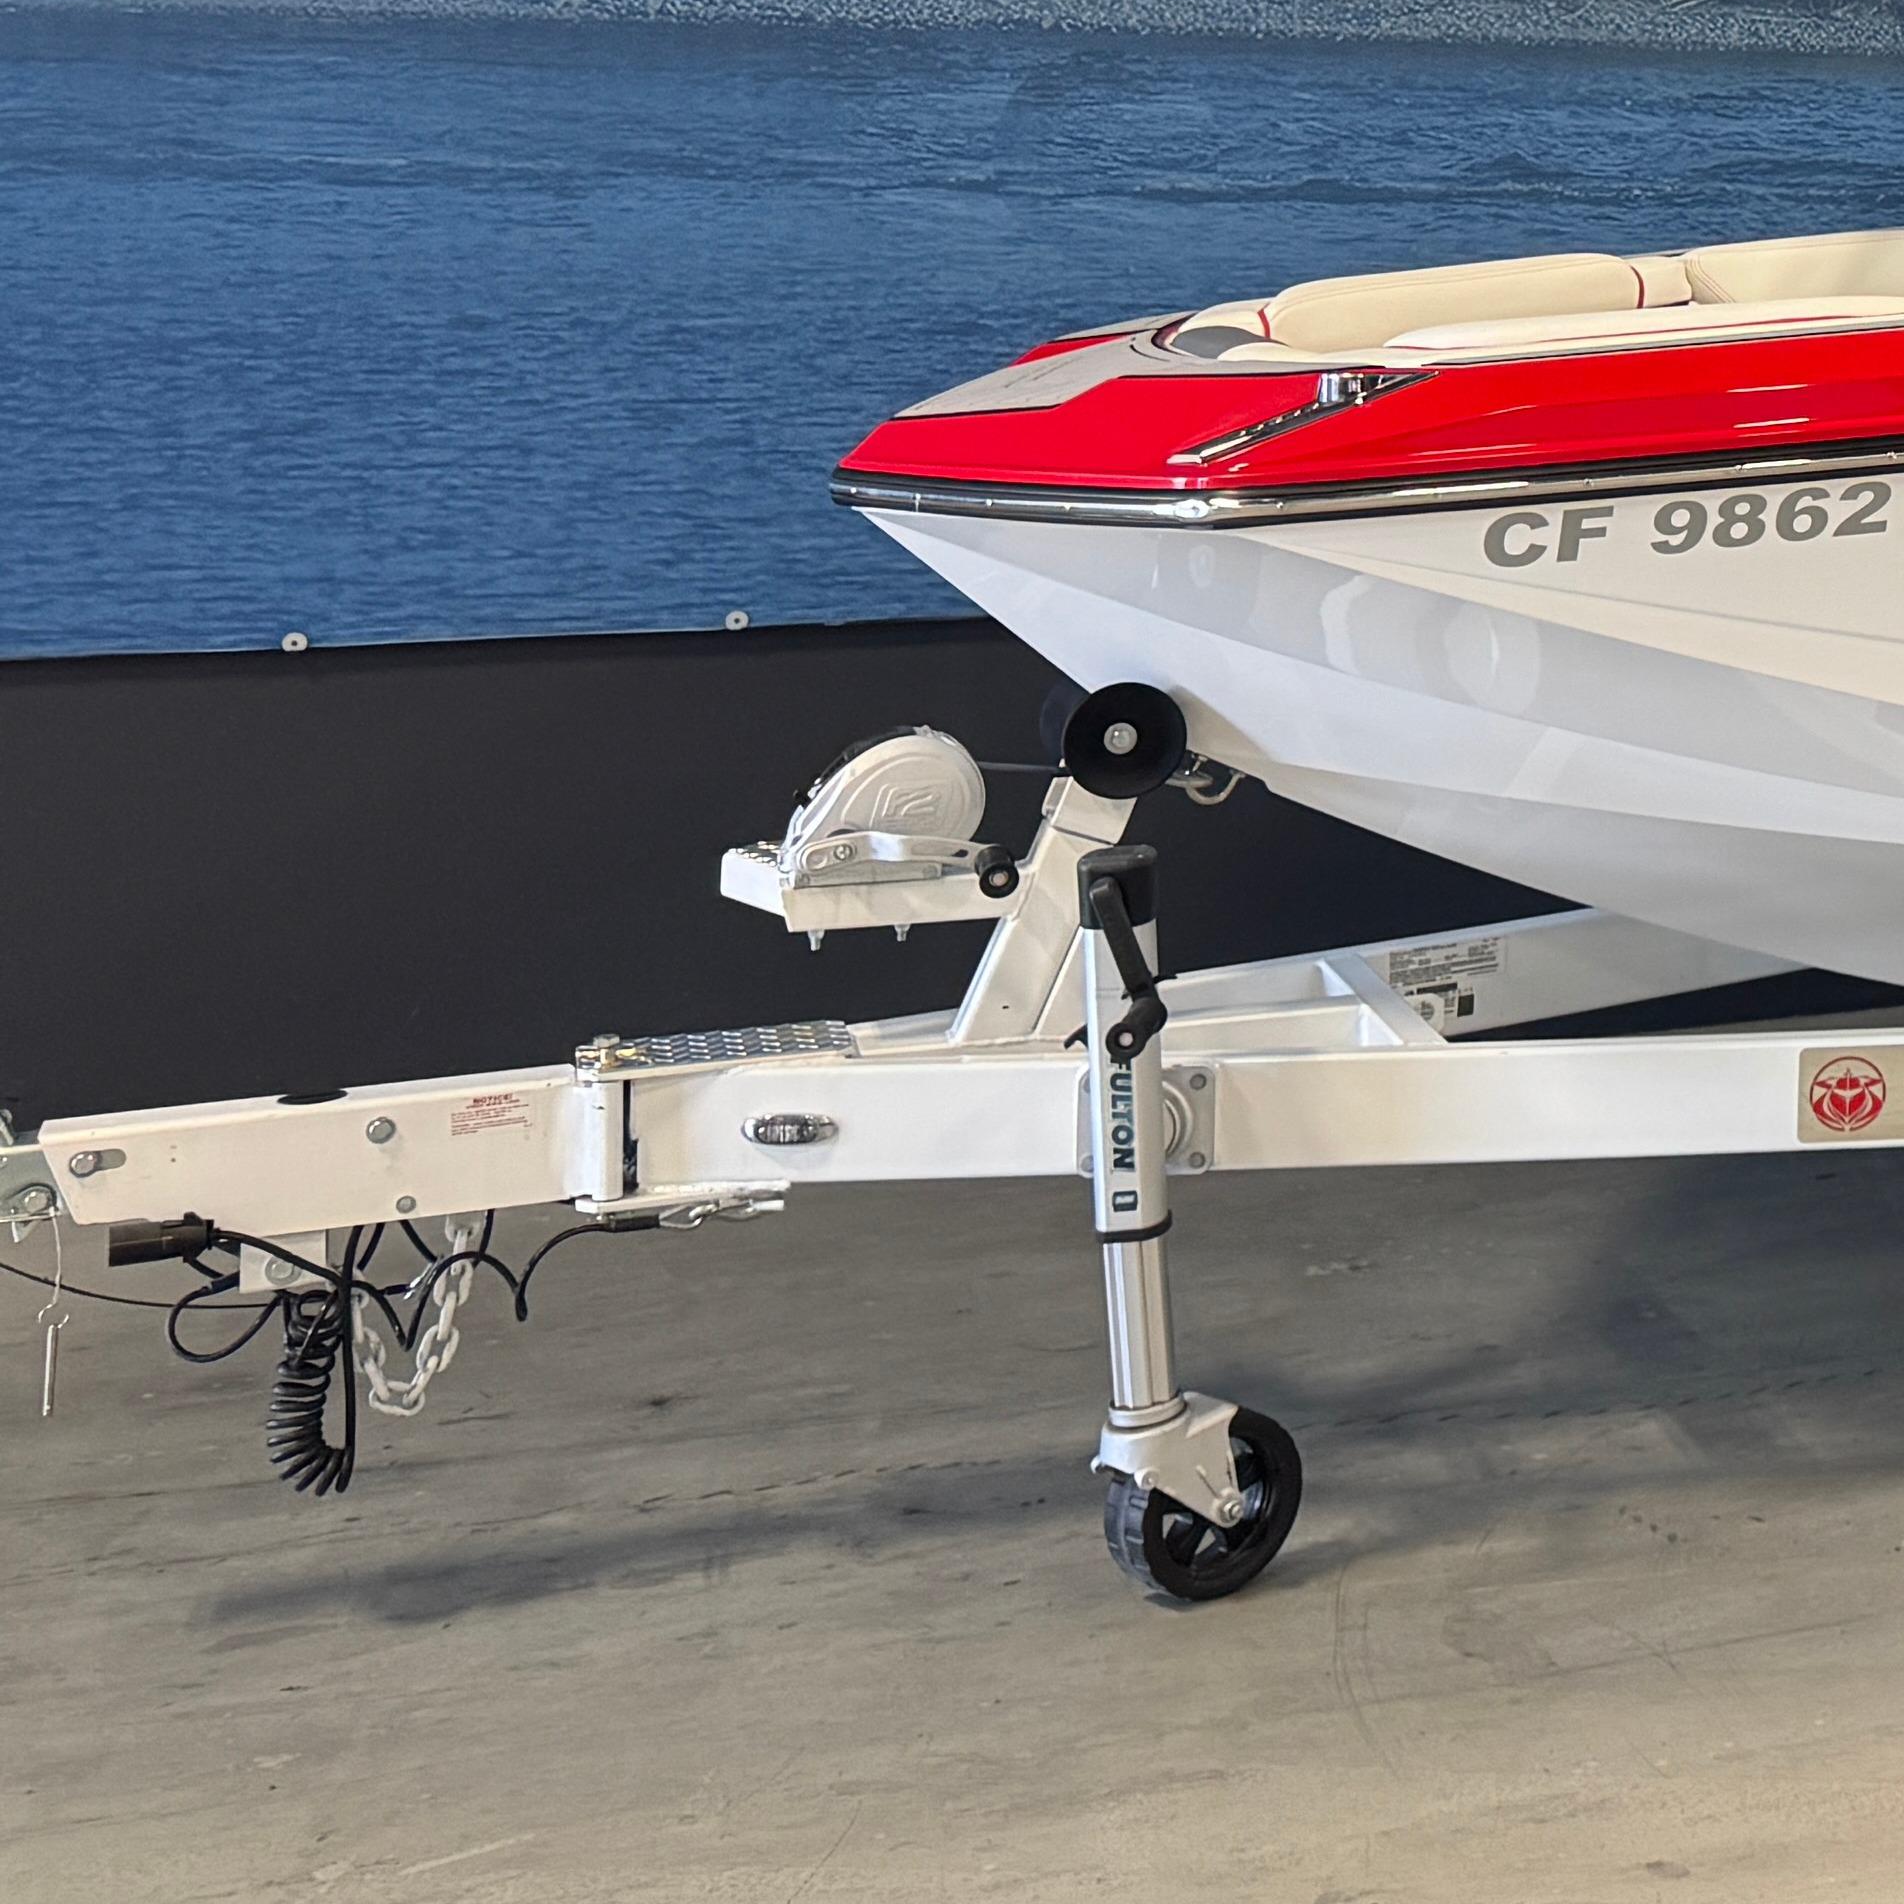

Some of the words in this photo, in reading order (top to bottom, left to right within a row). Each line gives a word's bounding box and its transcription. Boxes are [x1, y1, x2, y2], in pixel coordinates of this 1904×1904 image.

[1483, 506, 1615, 568] CF
[1650, 481, 1892, 555] 9862
[1110, 1056, 1134, 1169] FULTON
